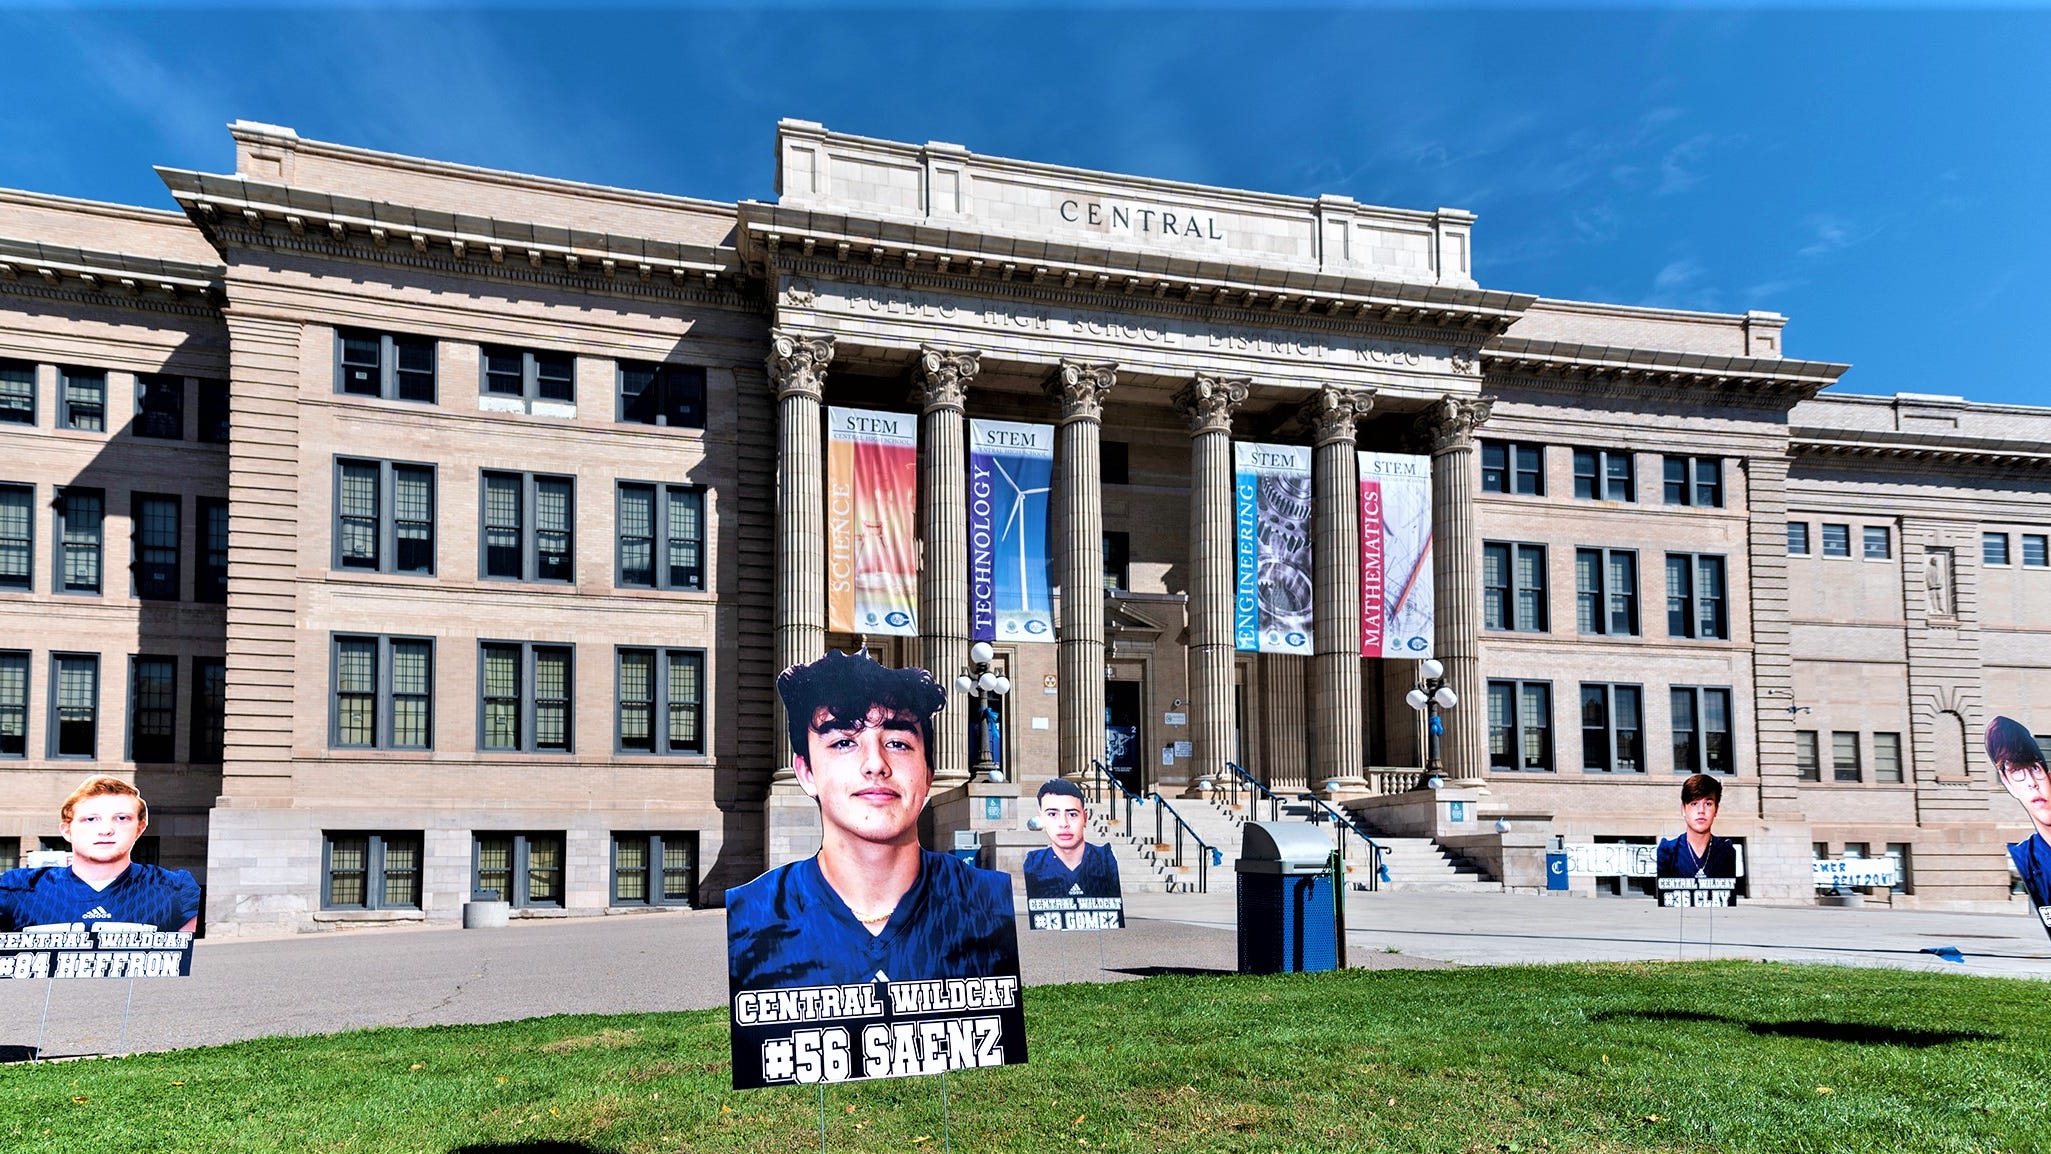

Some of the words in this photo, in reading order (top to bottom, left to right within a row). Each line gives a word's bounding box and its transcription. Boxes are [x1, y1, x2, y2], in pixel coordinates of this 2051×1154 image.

[1060, 199, 1223, 241] CENTRAL
[847, 287, 958, 319] PUEBLO
[982, 302, 1050, 331] HIGH
[1072, 314, 1176, 344] SCHOOL
[1207, 328, 1329, 358] DISTRICT
[846, 415, 898, 435] STEM
[986, 429, 1036, 447] STEM
[1251, 450, 1296, 468] STEM
[1374, 459, 1417, 476] STEM
[831, 483, 851, 593] SCIENCE
[972, 464, 992, 632] TECHNOLOGY
[1237, 484, 1255, 648] ENGINEERING
[1363, 490, 1380, 648] MATHEMATICS
[1657, 878, 1698, 890] CENTRAL
[1698, 877, 1737, 890] WILDCAT
[1028, 897, 1077, 911] CENTRAL
[1077, 897, 1122, 910] WILDCAT
[1664, 890, 1691, 908] #36
[1694, 890, 1731, 908] CLAY
[1034, 911, 1063, 931] #13
[1064, 910, 1120, 931] GOMEZ
[97, 931, 193, 950] WILDCAT
[0, 951, 51, 979] #84
[54, 950, 183, 978] HEFFRON
[735, 985, 884, 1027] CENTRAL
[888, 974, 1018, 1016] WILDCAT
[761, 1025, 851, 1084] #56
[862, 1015, 1005, 1079] SAENZ
